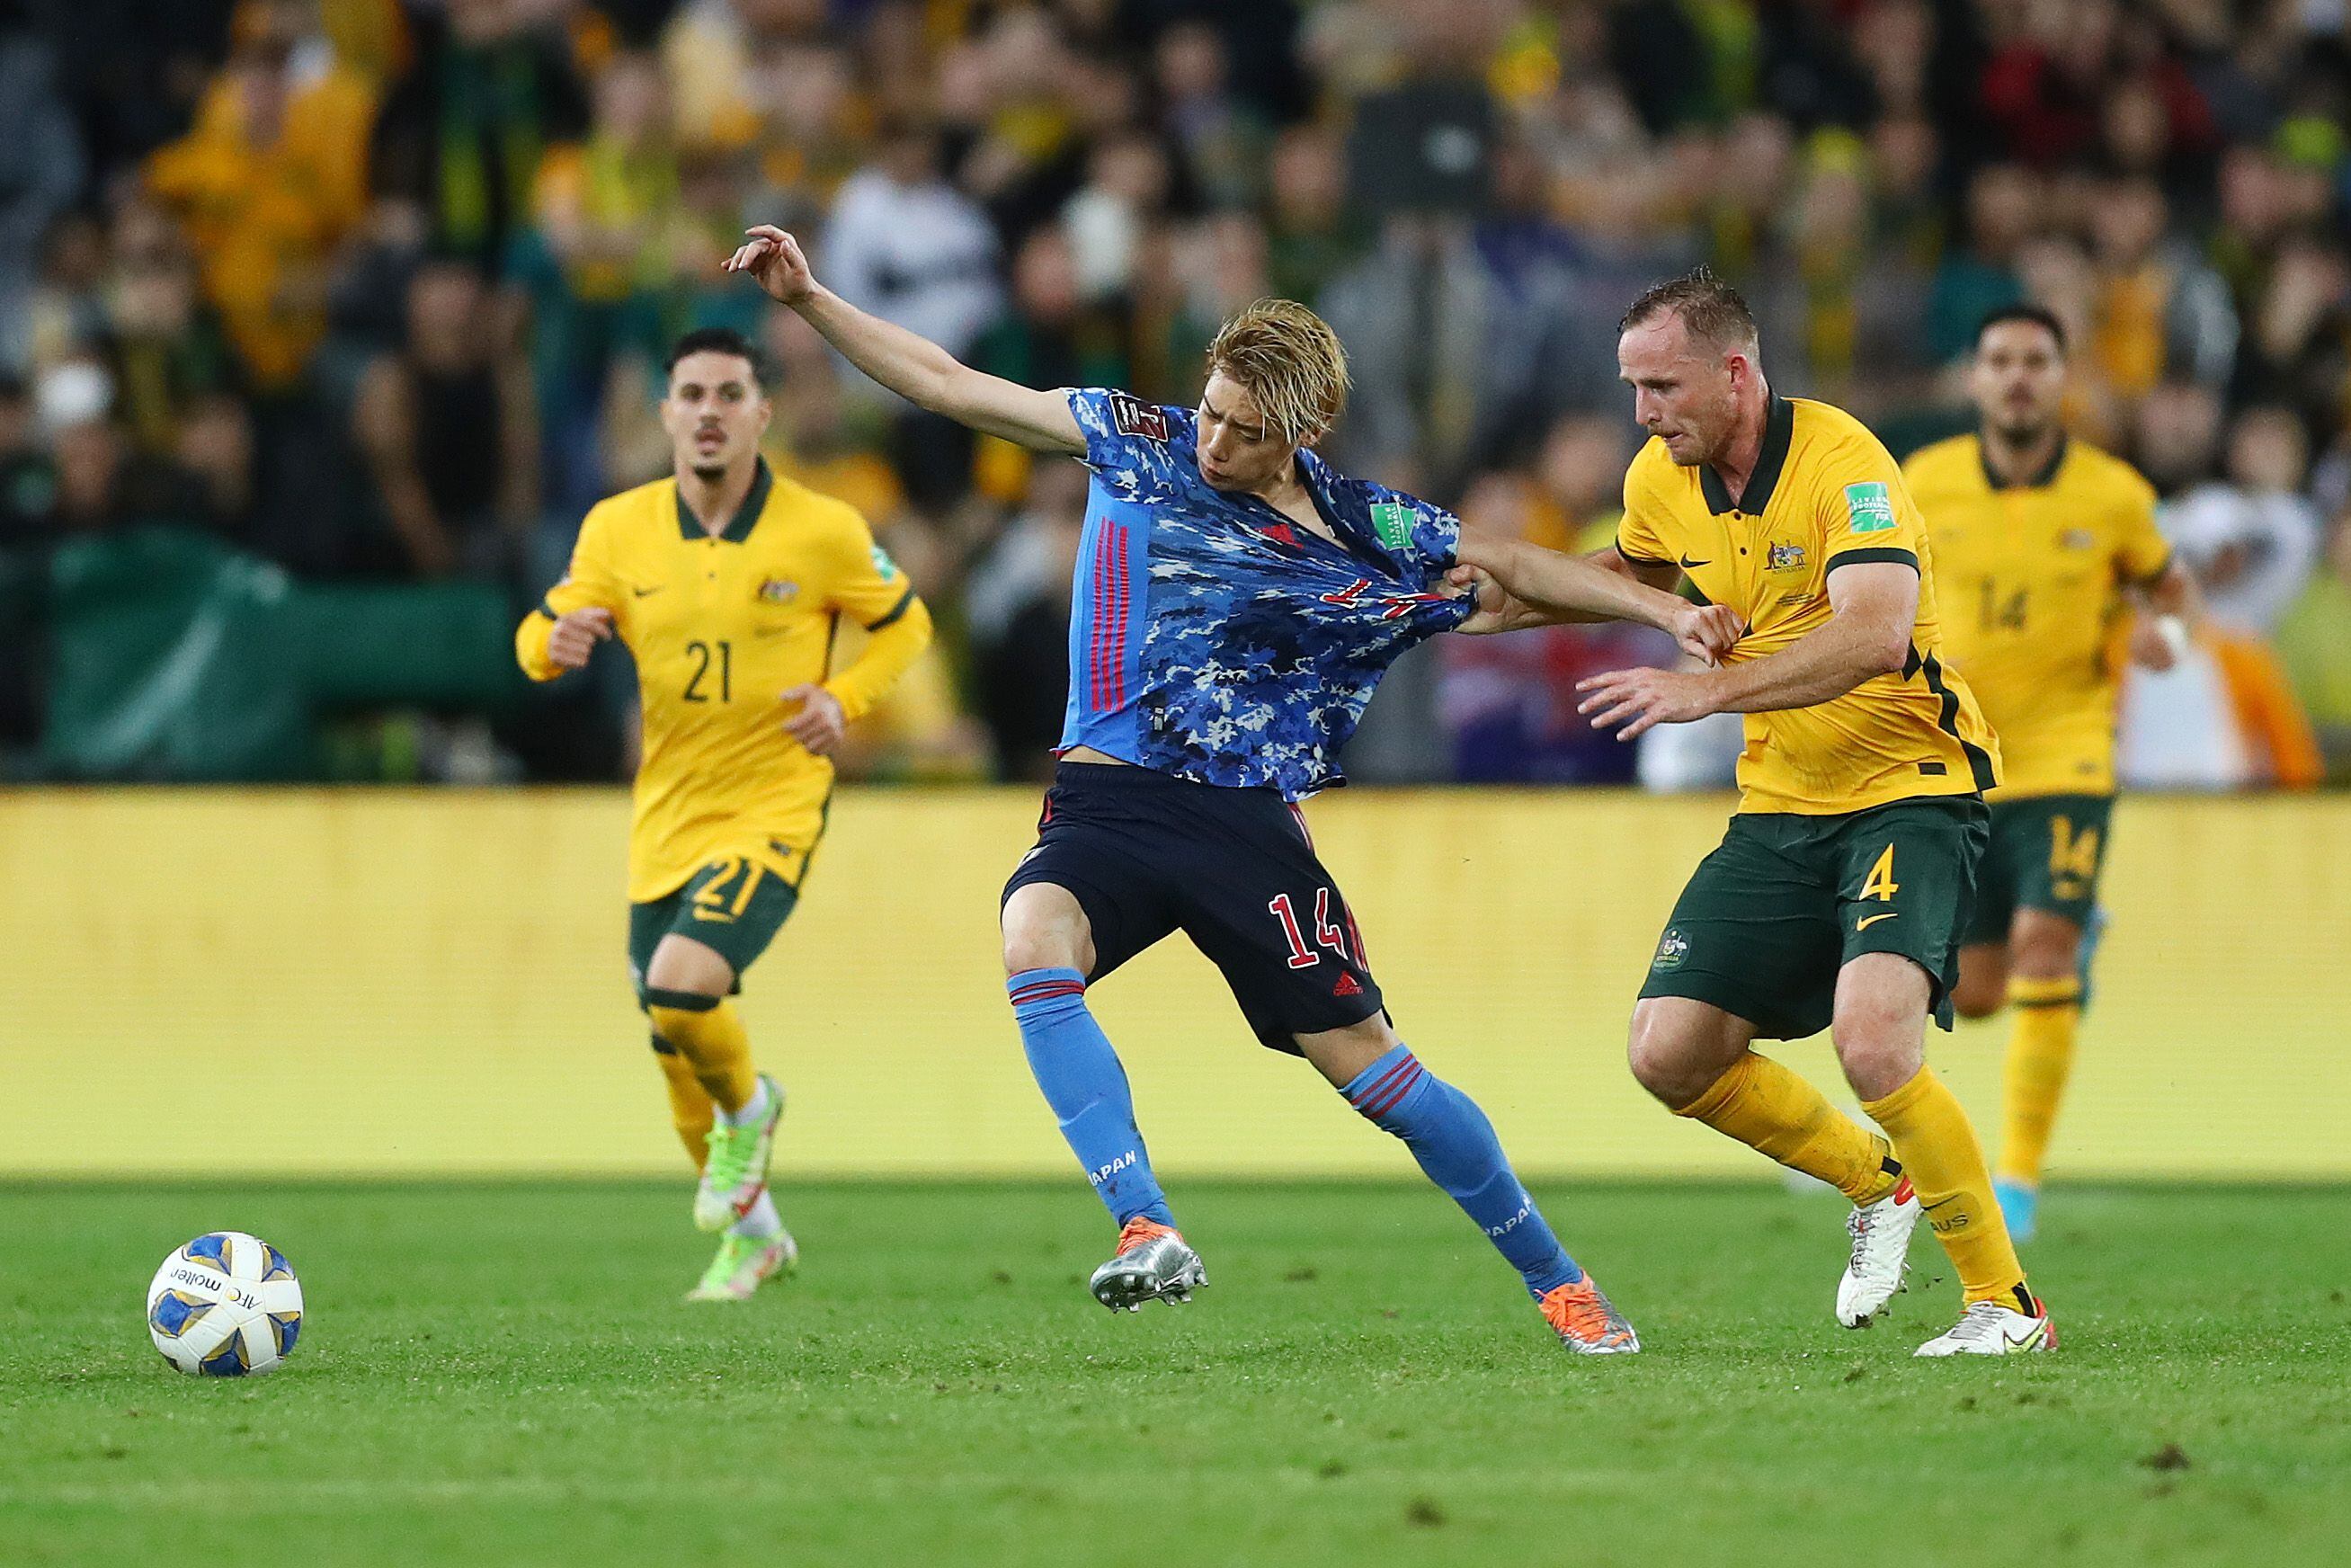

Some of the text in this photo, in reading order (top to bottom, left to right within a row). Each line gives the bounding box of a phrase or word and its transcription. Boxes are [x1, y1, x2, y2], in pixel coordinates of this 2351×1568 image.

[683, 639, 731, 702] 21
[693, 855, 763, 916] 21
[1858, 842, 1899, 902] 4
[1269, 887, 1349, 969] 14
[1485, 1193, 1531, 1237] APAN
